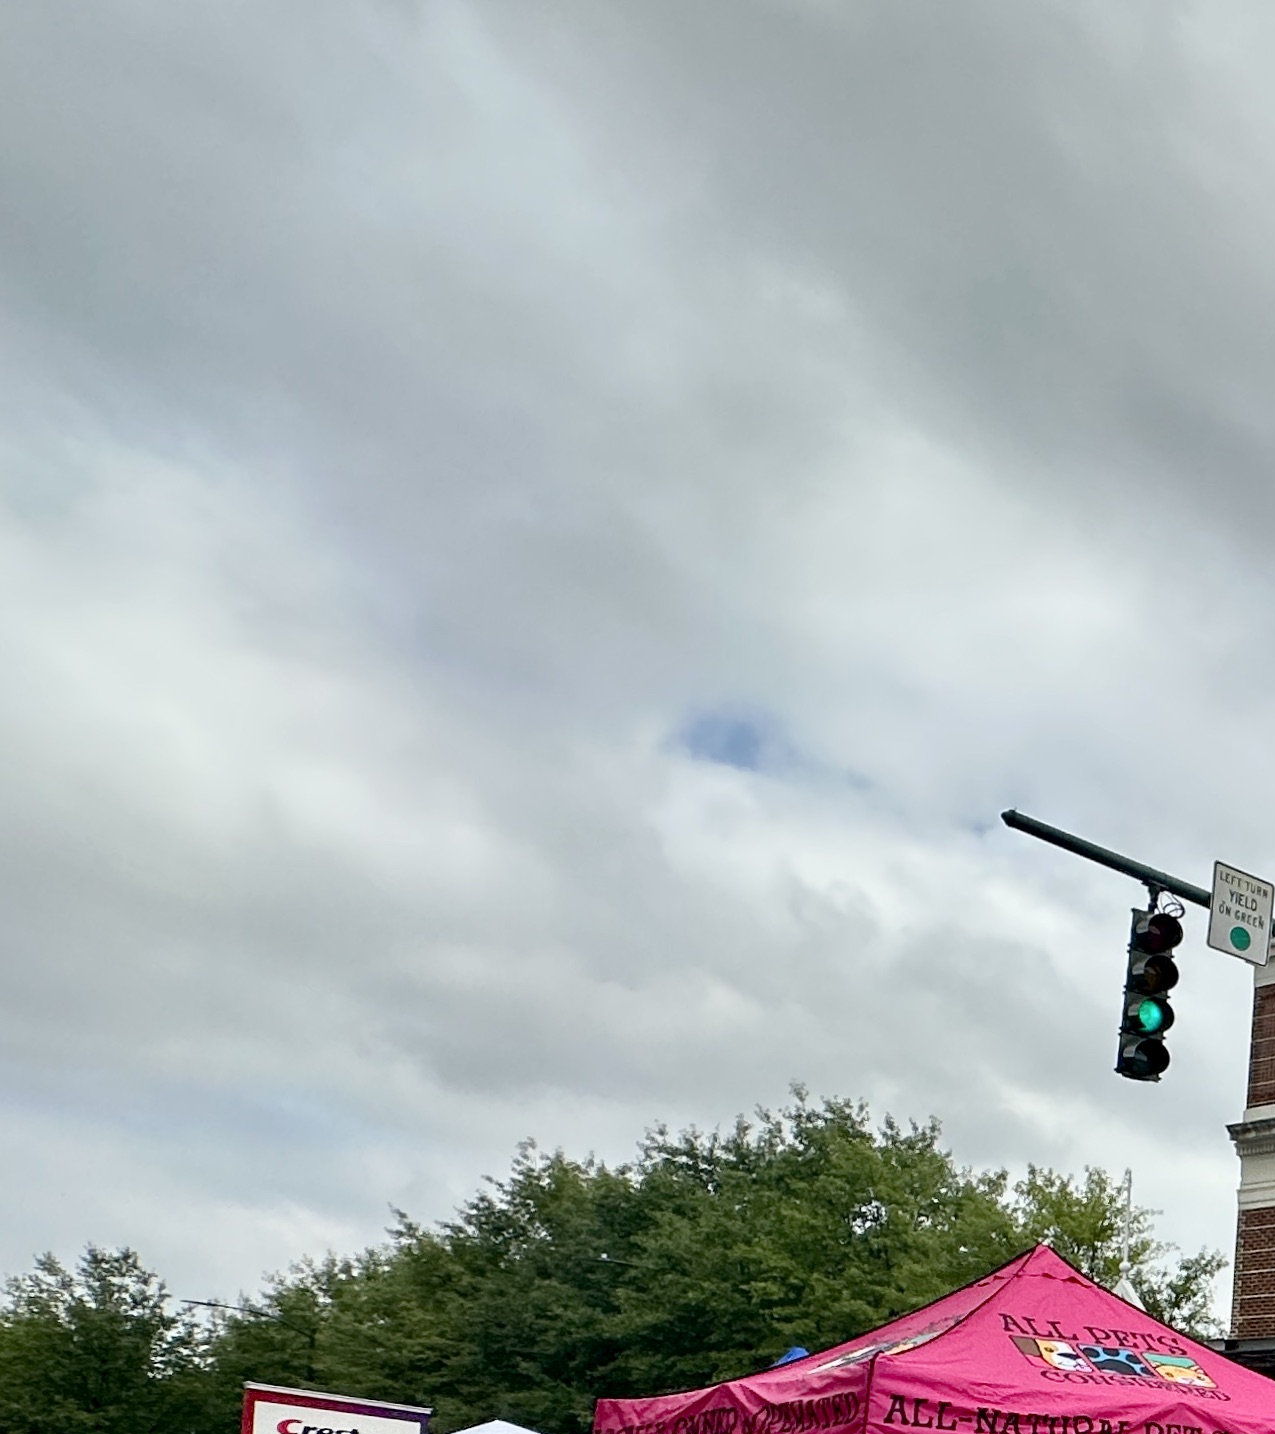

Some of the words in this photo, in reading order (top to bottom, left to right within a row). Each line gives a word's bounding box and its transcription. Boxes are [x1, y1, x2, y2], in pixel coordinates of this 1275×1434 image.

[1219, 870, 1242, 887] LEFT
[1244, 880, 1268, 899] TURN
[1229, 889, 1258, 912] YIELD
[1218, 904, 1231, 917] ON
[1234, 911, 1265, 930] GREEN
[998, 1313, 1078, 1341] ALL
[1083, 1326, 1189, 1356] PETS
[1040, 1370, 1232, 1402] CONSIDERED
